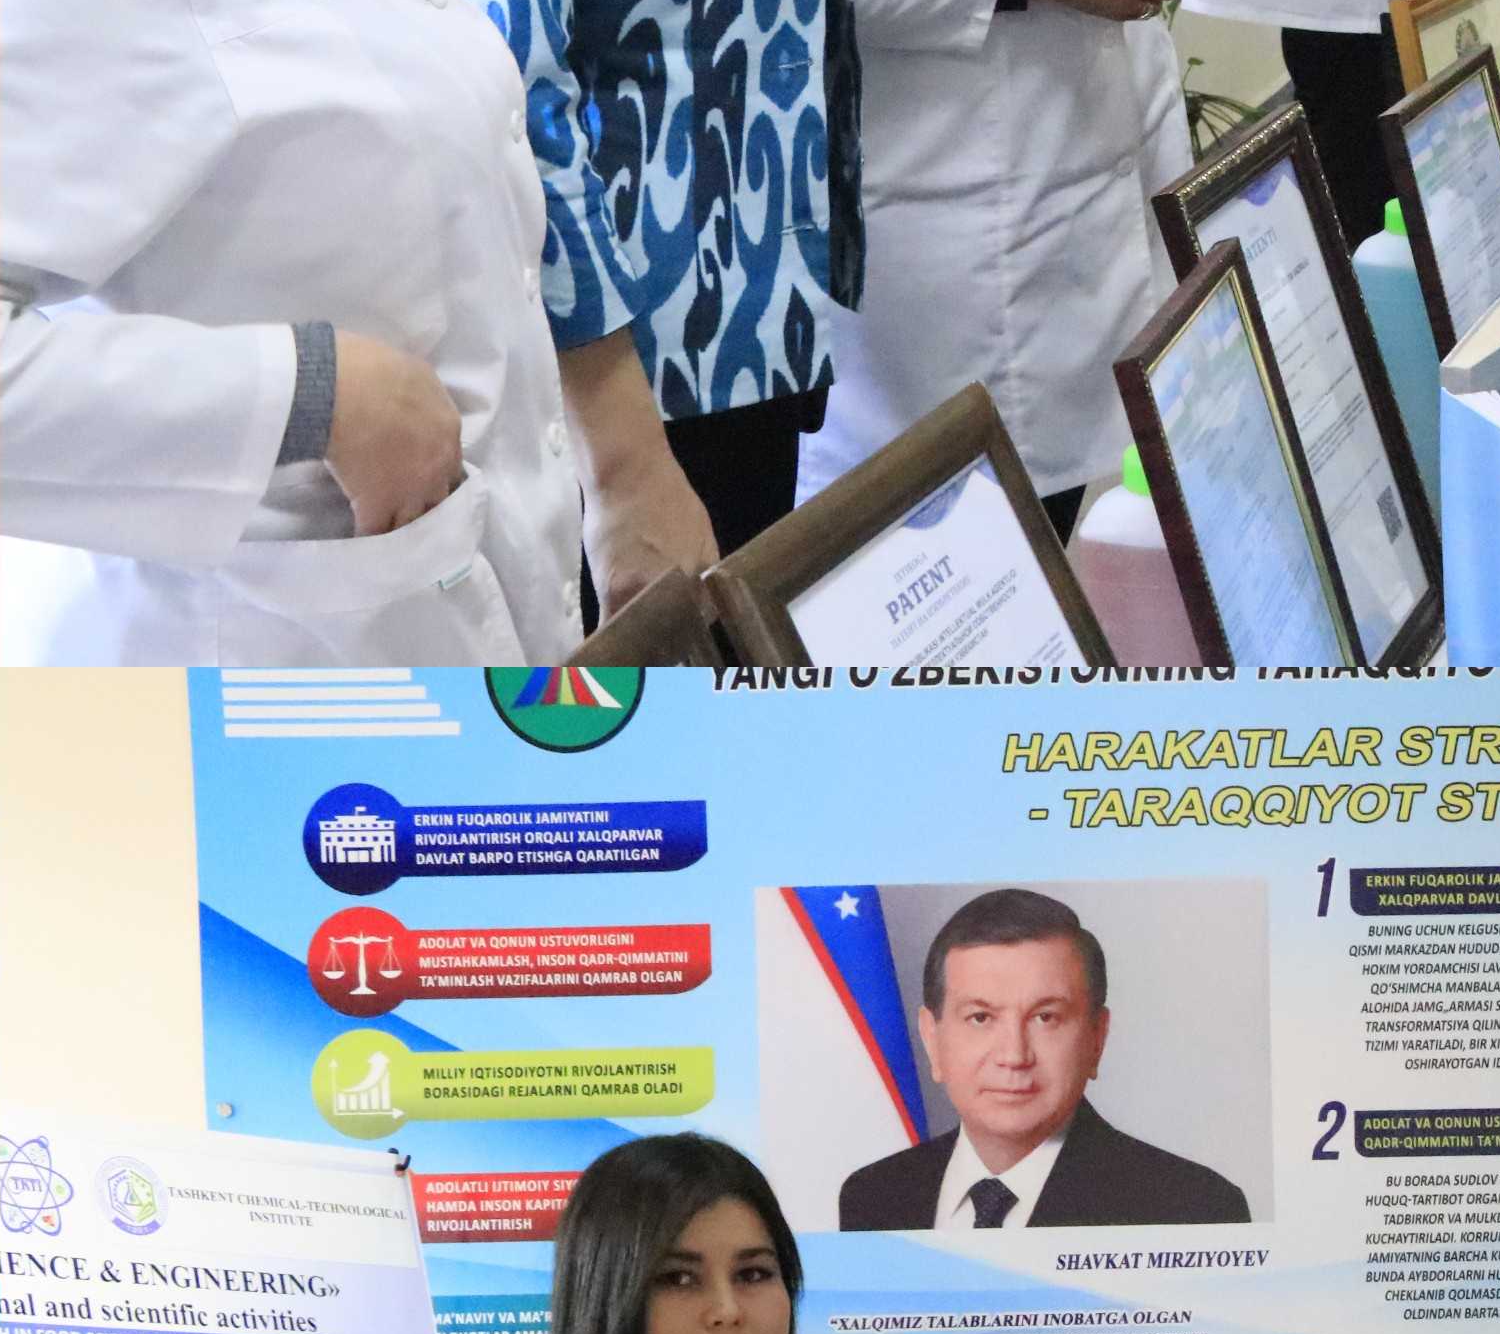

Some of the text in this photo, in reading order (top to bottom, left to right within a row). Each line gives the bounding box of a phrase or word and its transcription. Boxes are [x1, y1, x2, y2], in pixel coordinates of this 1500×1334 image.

[886, 555, 955, 624] PATENT
[1002, 726, 1382, 772] HARAKATLAR
[1064, 783, 1428, 829] TARAQQIYOT
[414, 811, 608, 826] ERKIN FUQAROLIK JAMIYATINI
[416, 829, 662, 845] RIVOJLANTIRISH ORQALI XALQPARVAR
[416, 849, 659, 864] DAVLAT BARPO ETISHGA QARATILGAN
[1318, 858, 1335, 917] 1
[1367, 875, 1405, 886] ERKIN
[1410, 874, 1484, 887] FUQAROLIK
[1379, 894, 1464, 906] XALQPARVAR
[1369, 925, 1412, 936] BUNING
[1416, 925, 1455, 936] UCHUN
[419, 934, 633, 949] ADOLAT VA QONUN USTUVORLIGINI
[419, 952, 688, 968] MUSTAHKAMLASH, INSON QADR-QIMMATINI
[497, 974, 579, 985] VAZIFALARINI
[583, 972, 637, 985] QAMRAB
[641, 971, 682, 983] OLGAN
[424, 1064, 676, 1079] MILLIY IQTISODIYOTNI RIVOJLANTIRISH
[424, 1083, 682, 1098] BORASIDAGI REJALARNI QAMRAB OLADI
[168, 1185, 407, 1221] TASHKENT CHEMICAL-TECHNOLOGICAL
[249, 1212, 314, 1229] INSTITUTE
[1056, 1251, 1268, 1270] SHAVKAT MIRZIYOYEV
[100, 1260, 121, 1283] &
[131, 1261, 341, 1299] ENGINEERING»
[46, 1297, 92, 1319] and
[101, 1298, 208, 1329] scientific
[216, 1306, 317, 1334] activities
[928, 1314, 1038, 1328] TALABLARINI
[1044, 1313, 1128, 1325] INOBATGA
[1133, 1311, 1191, 1324] OLGAN
